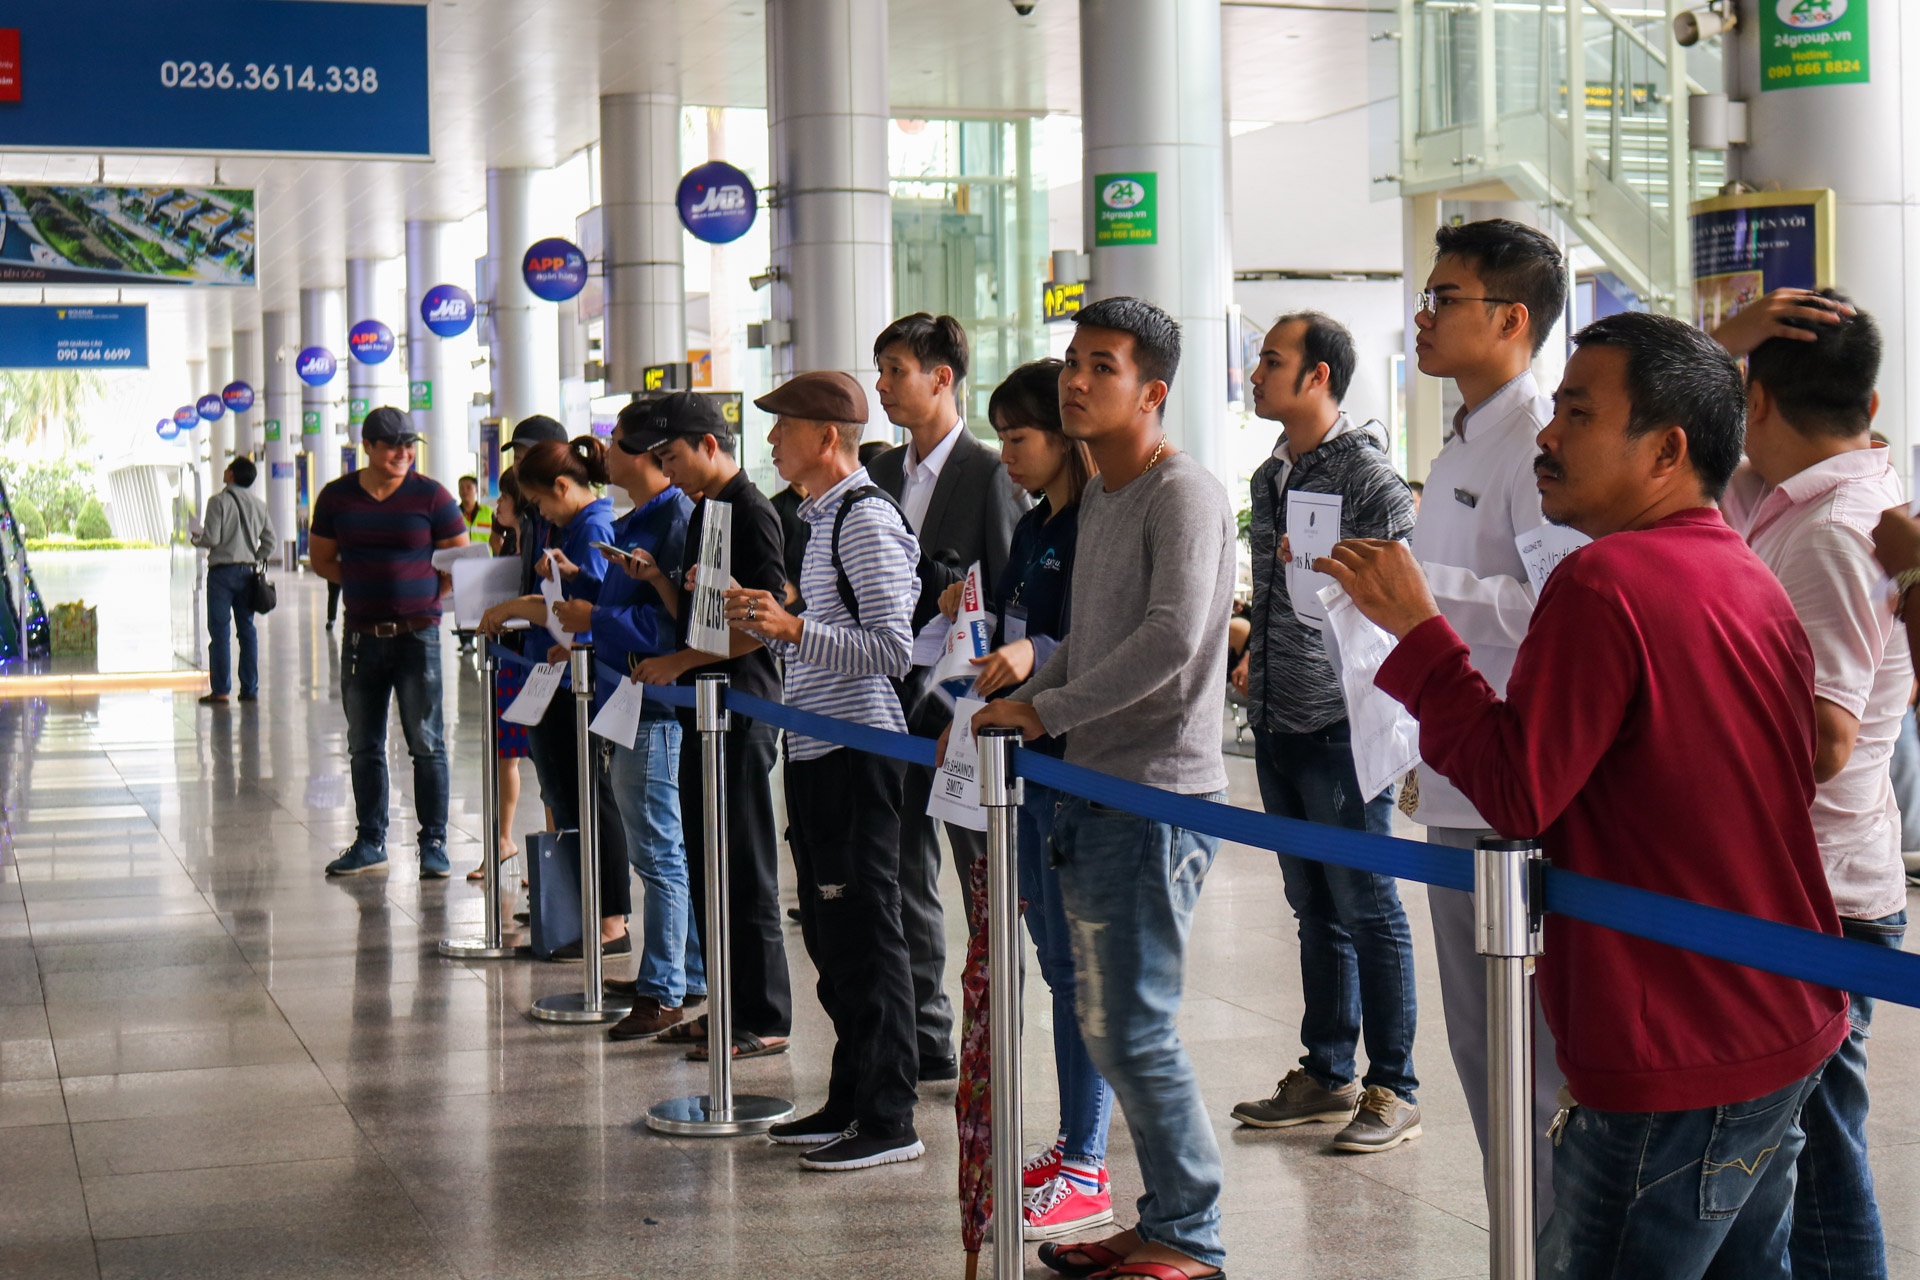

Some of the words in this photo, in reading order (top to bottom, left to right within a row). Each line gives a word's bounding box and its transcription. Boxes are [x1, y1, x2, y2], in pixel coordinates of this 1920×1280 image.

[1774, 30, 1853, 48] 24group.vn
[1791, 50, 1832, 61] Hotline:
[161, 61, 379, 93] 0236.3614.338
[1768, 65, 1793, 79] 090
[1795, 61, 1821, 75] 666
[1825, 59, 1860, 74] 8824
[691, 184, 746, 214] MB
[1110, 182, 1135, 199] 24
[1102, 210, 1147, 221] 24group.vn
[528, 257, 565, 272] APP
[429, 299, 467, 317] MB
[352, 333, 378, 345] APP
[57, 348, 78, 361] 090
[80, 348, 101, 361] 464
[103, 347, 131, 361] 6699
[537, 664, 562, 676] WELE
[950, 759, 975, 779] SHANNON
[946, 778, 964, 796] SMITH
